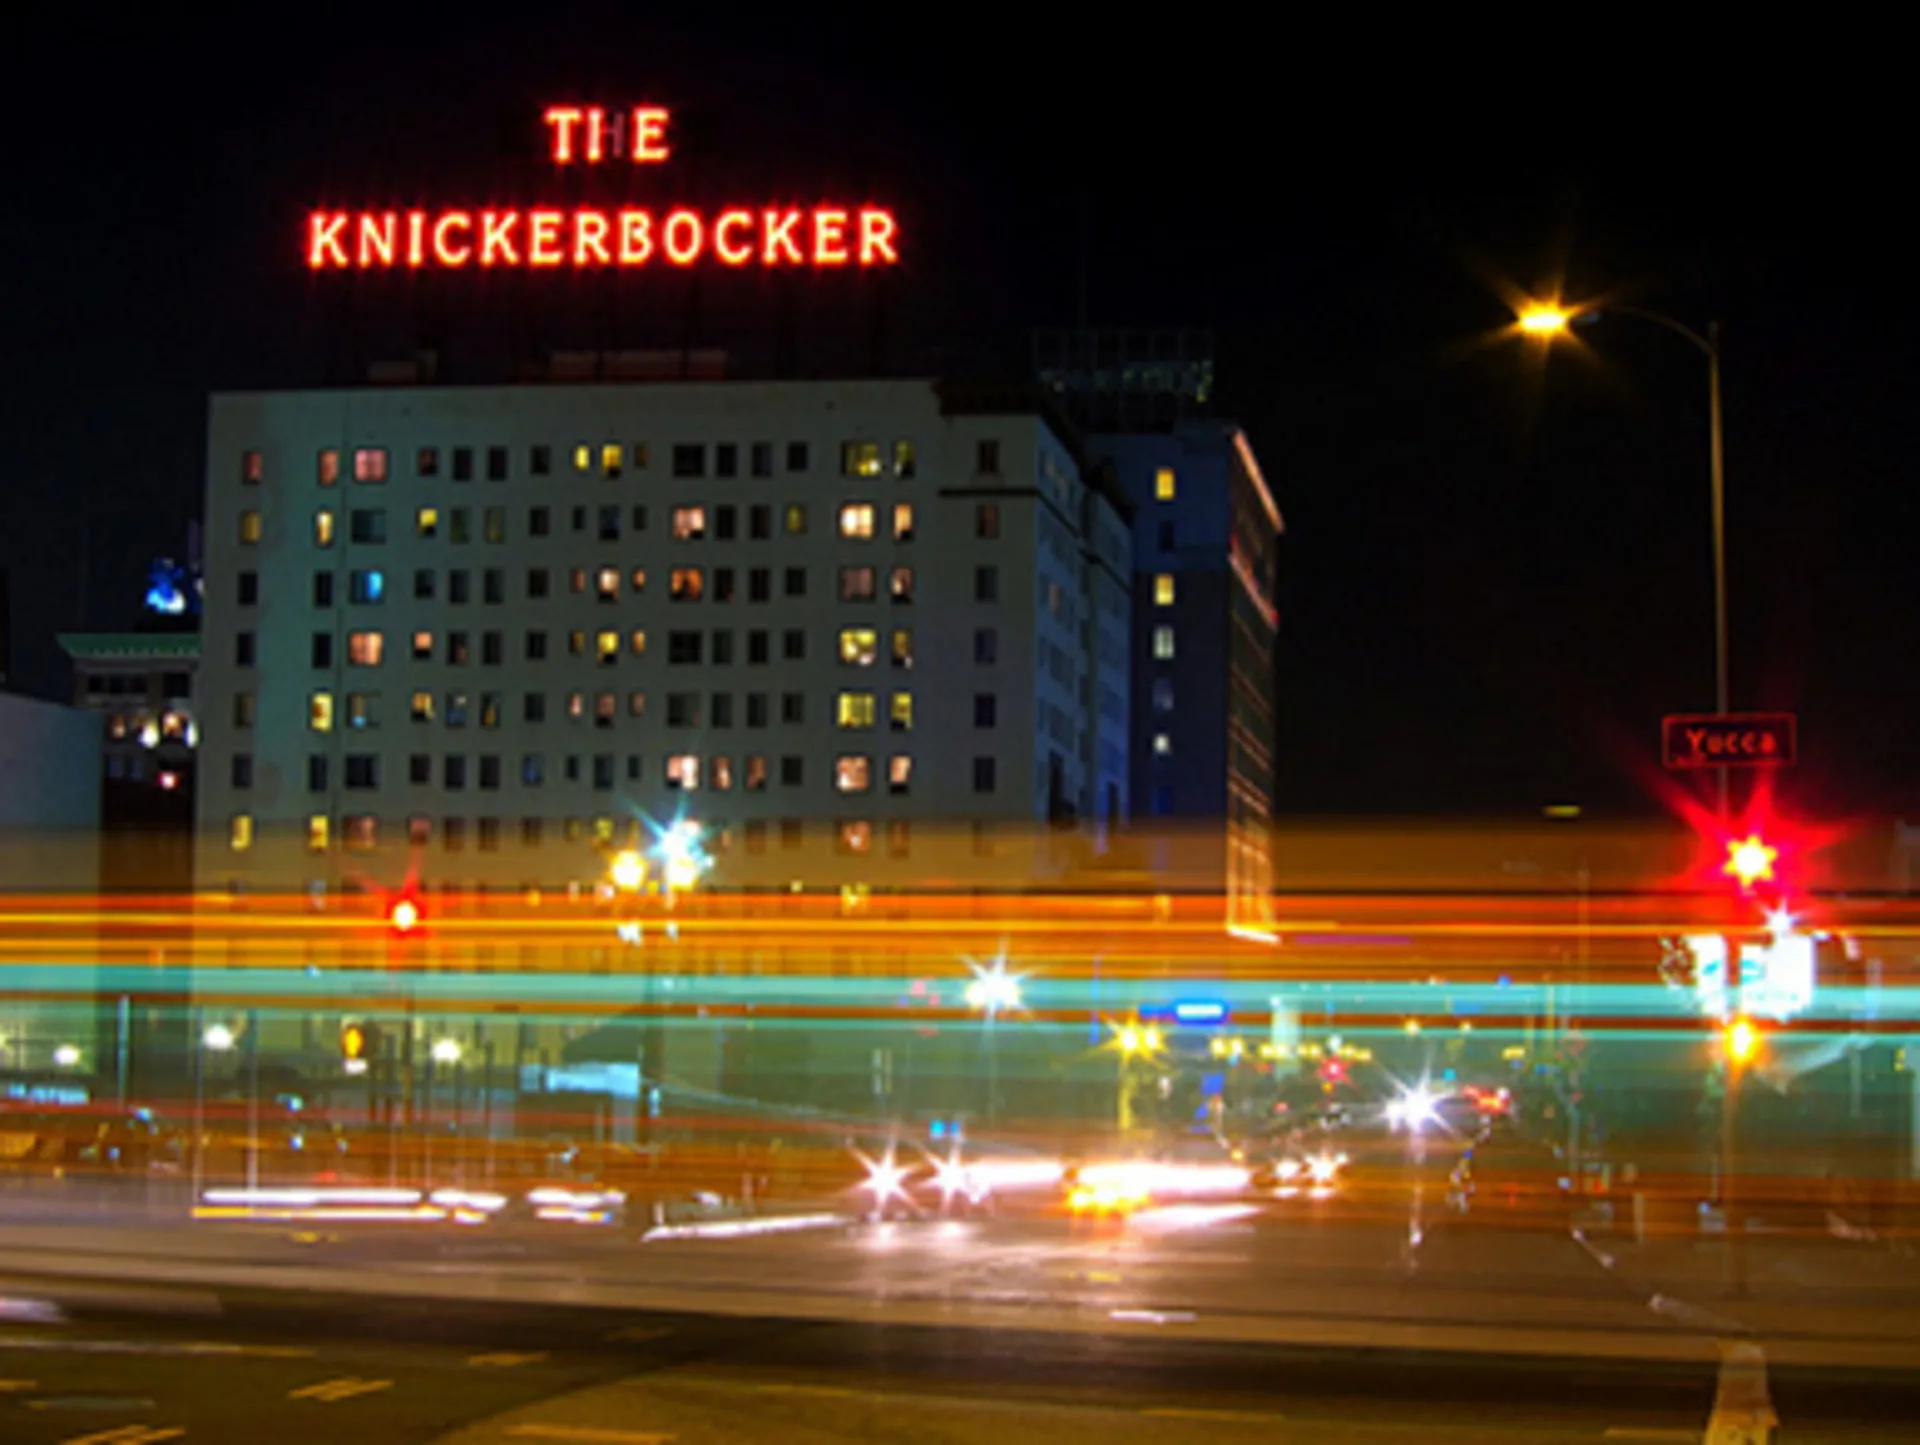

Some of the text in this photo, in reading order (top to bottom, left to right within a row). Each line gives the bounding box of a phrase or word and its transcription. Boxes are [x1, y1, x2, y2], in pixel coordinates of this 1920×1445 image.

[544, 106, 671, 164] THE
[307, 208, 900, 270] KNICKERBOCKER
[1684, 727, 1778, 755] Yucca
